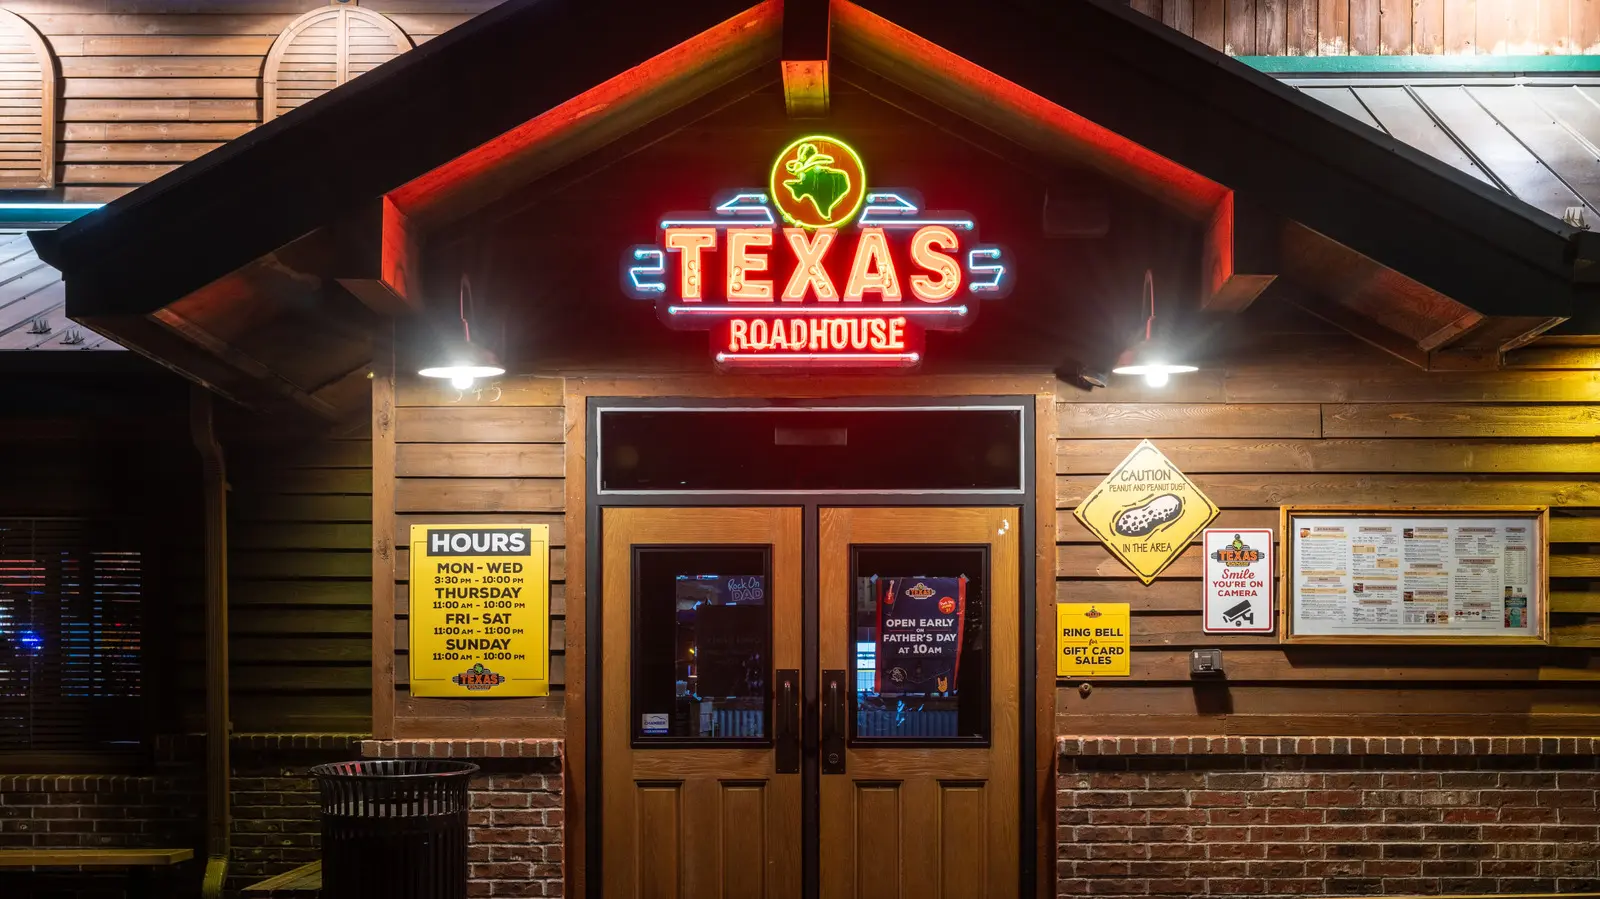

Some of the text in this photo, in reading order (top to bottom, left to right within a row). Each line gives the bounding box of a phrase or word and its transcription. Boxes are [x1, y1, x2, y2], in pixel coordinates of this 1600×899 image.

[664, 225, 962, 303] TEXAS
[730, 318, 905, 351] ROADHOUSE
[1121, 469, 1171, 482] CAUTION
[1109, 483, 1186, 492] PEANUT AND PEANUT DUST
[432, 533, 526, 553] HOURS
[1122, 543, 1172, 553] IN THE AREA
[1219, 551, 1258, 561] TEXAS
[437, 563, 474, 574] MON
[486, 563, 524, 574] WED
[1222, 568, 1255, 579] Smile
[728, 577, 760, 591] Rock On
[435, 588, 522, 598] THURSDAY
[732, 588, 763, 601] DAD
[446, 614, 470, 624] FRI
[482, 614, 512, 624] SAT
[886, 619, 916, 627] OPEN
[1064, 628, 1123, 636] RING BELL
[883, 634, 956, 642] FATHER'S DAY
[446, 639, 511, 650] SUNDAY
[1063, 647, 1124, 655] GIFT CARD
[1076, 656, 1112, 664] SALES
[460, 674, 498, 684] TEXAS
